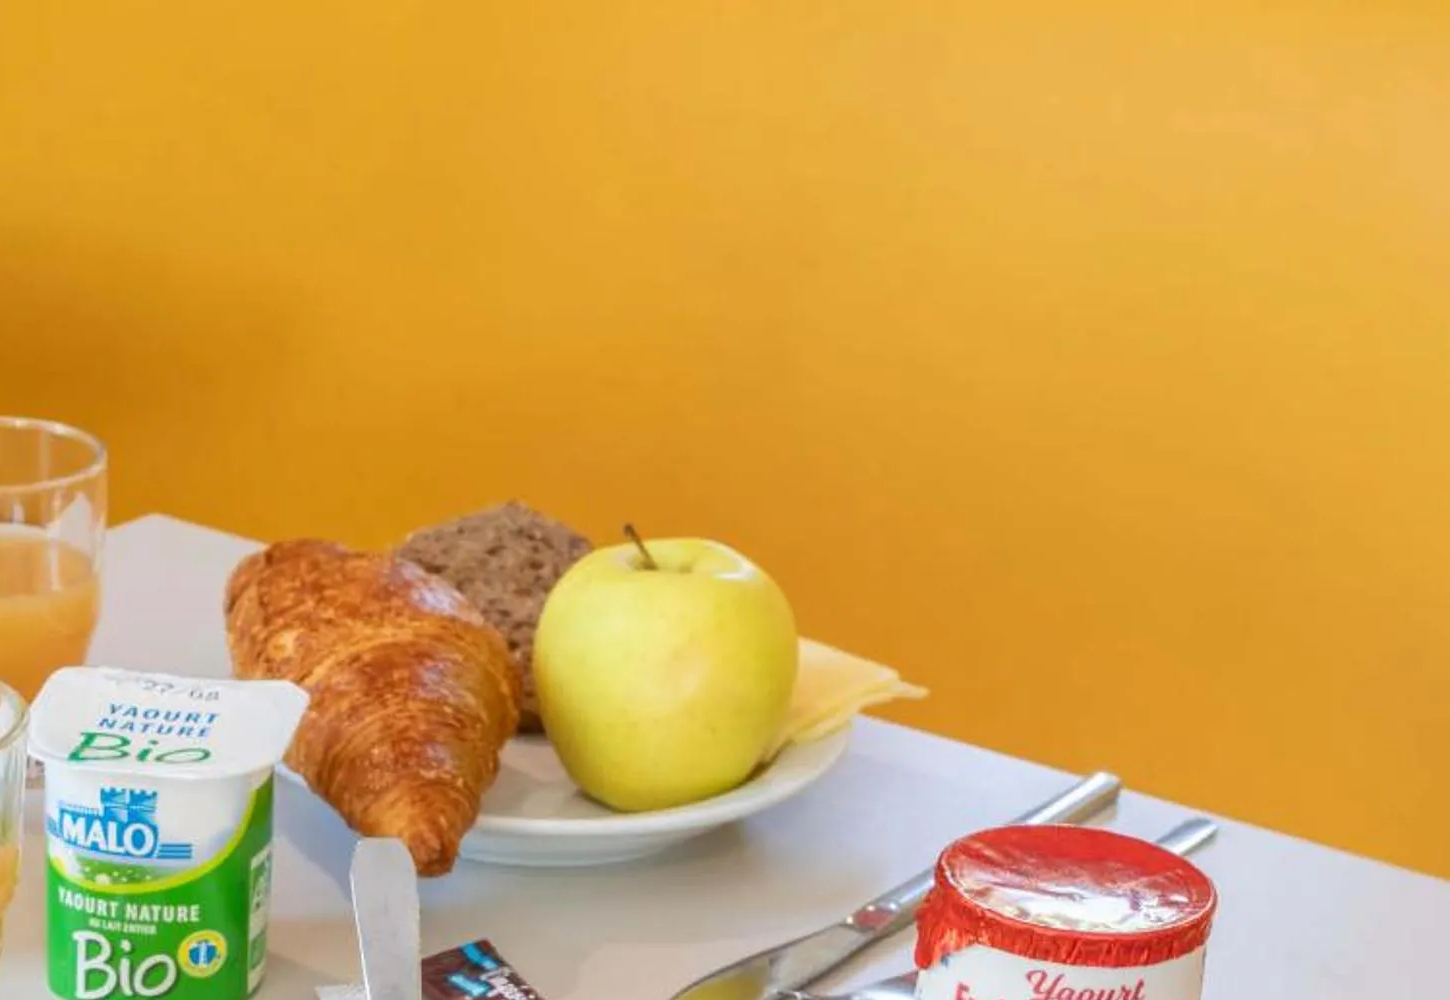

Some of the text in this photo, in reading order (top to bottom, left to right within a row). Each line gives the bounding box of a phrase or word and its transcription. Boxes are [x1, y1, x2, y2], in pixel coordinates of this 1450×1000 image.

[98, 718, 212, 738] NATURE
[108, 703, 221, 725] YAOURT
[67, 732, 212, 764] Bio
[62, 813, 155, 856] MALO
[57, 885, 201, 923] YAOURT NATURE
[72, 930, 178, 1000] Bio
